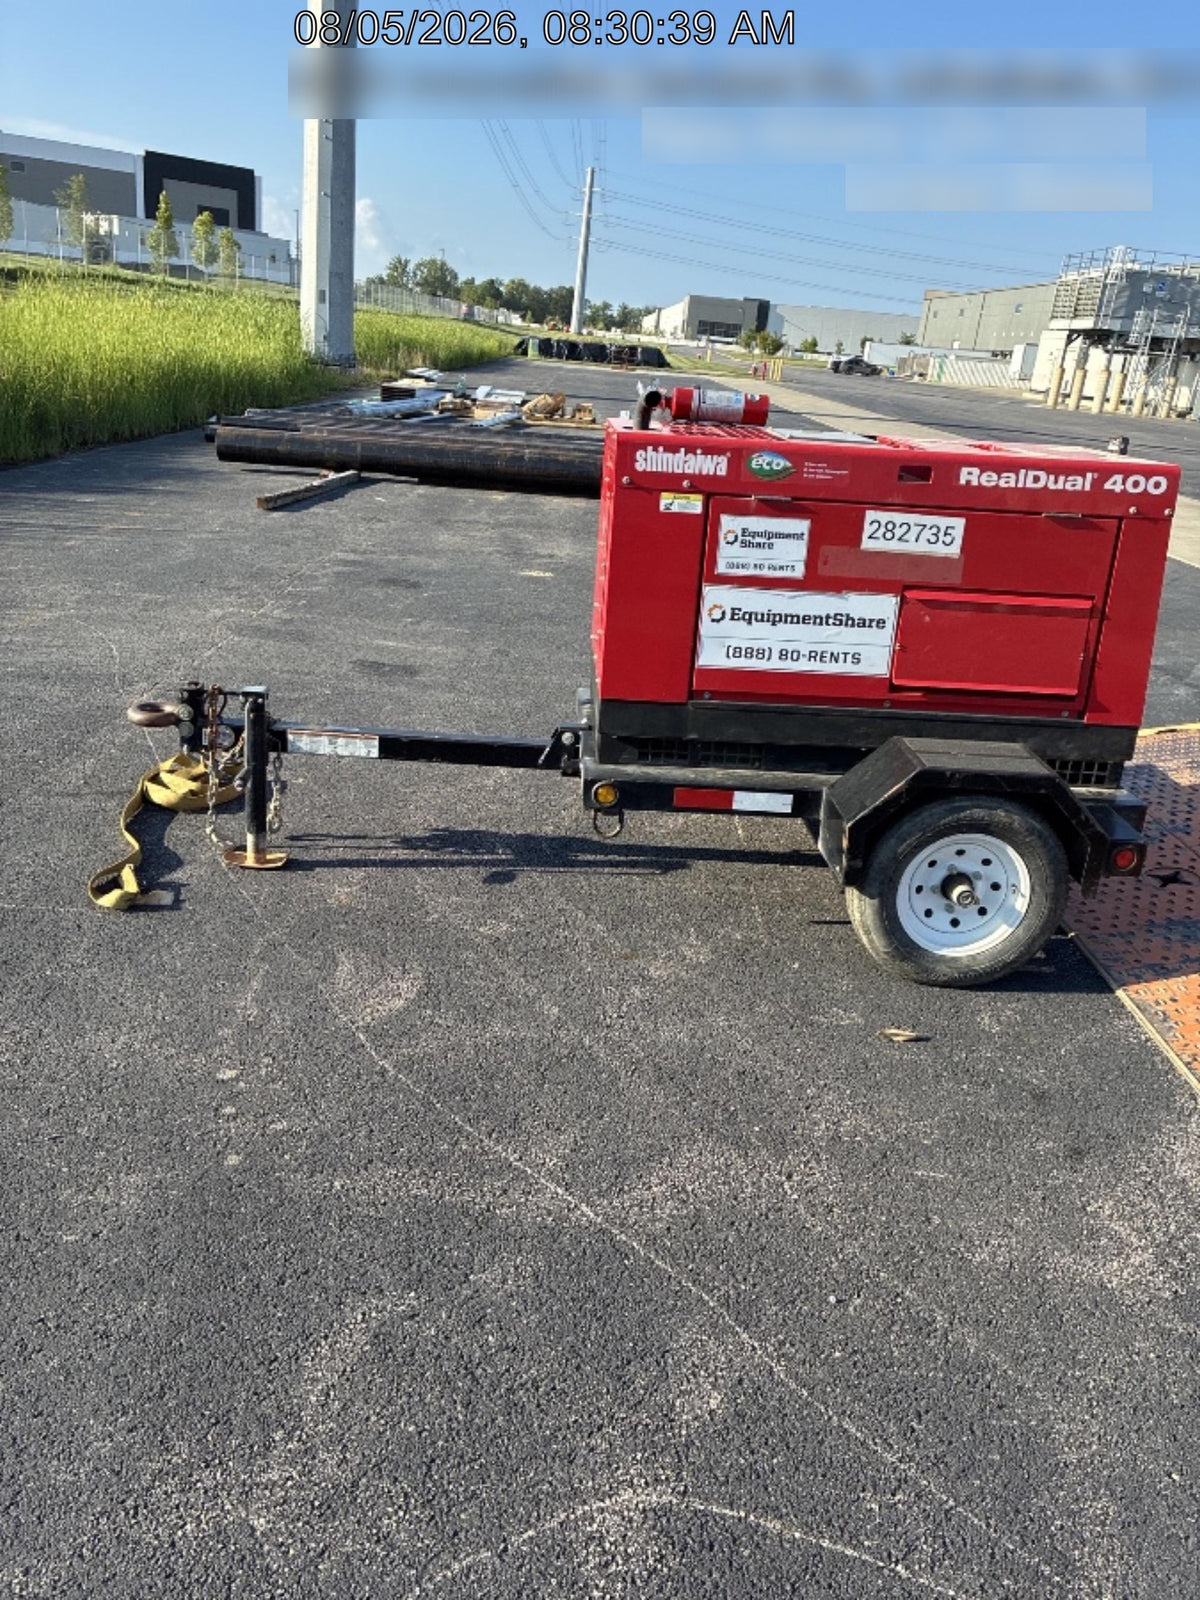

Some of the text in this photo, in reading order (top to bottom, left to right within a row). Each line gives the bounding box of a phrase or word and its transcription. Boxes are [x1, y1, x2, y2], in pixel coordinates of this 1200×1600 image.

[634, 445, 728, 476] shindaiwa
[751, 454, 785, 470] eco
[959, 467, 1168, 495] RealDual 400
[740, 527, 806, 541] Equipment
[867, 519, 956, 546] 282735
[739, 539, 774, 550] Share
[729, 607, 887, 630] EquipmentShare
[725, 645, 862, 665] (888) 80-RENTS
